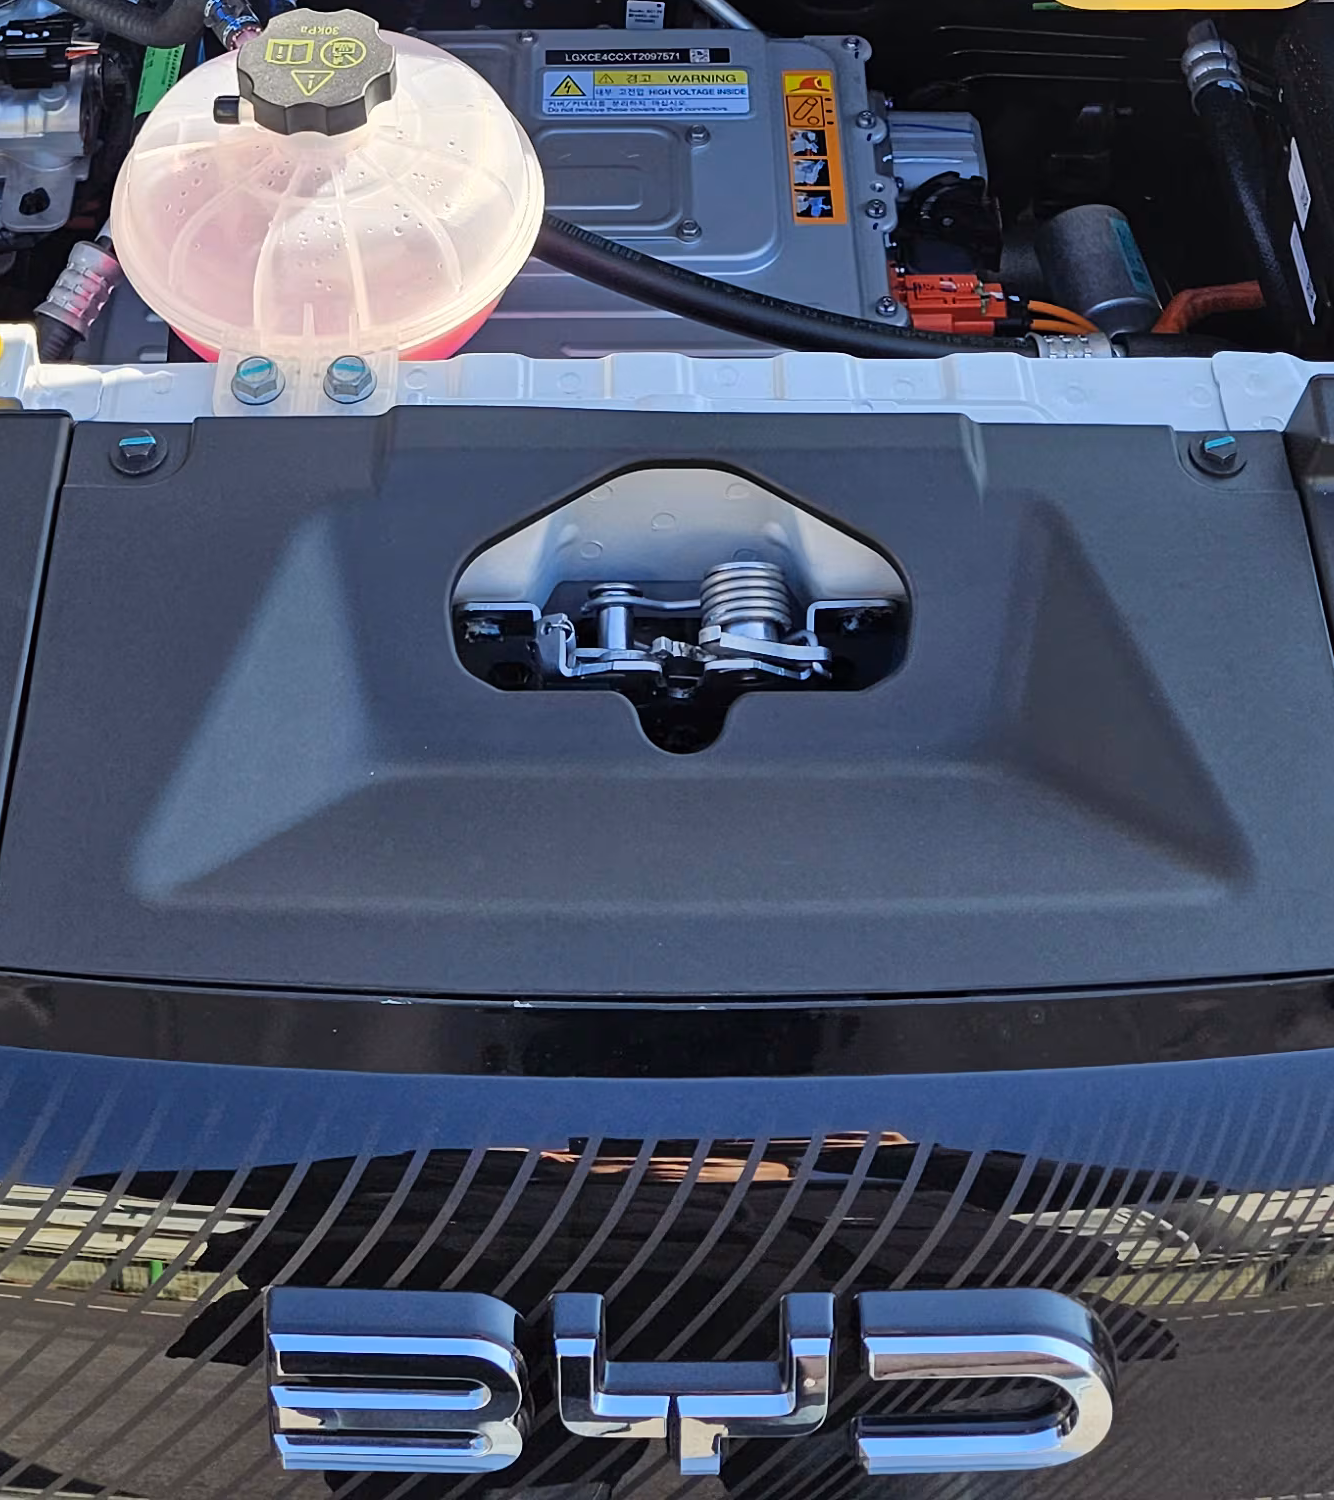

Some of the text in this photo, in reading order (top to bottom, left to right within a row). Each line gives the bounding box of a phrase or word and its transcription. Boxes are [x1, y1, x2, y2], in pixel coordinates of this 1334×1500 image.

[301, 25, 340, 36] 30kPa
[564, 52, 681, 63] LGXCE4CCXT2097571
[626, 74, 737, 84] 경고 WARNING
[648, 88, 672, 96] HIGH
[673, 88, 715, 96] VOLTAGE
[716, 87, 747, 96] INSIDE
[265, 1285, 1118, 1477] BYD
